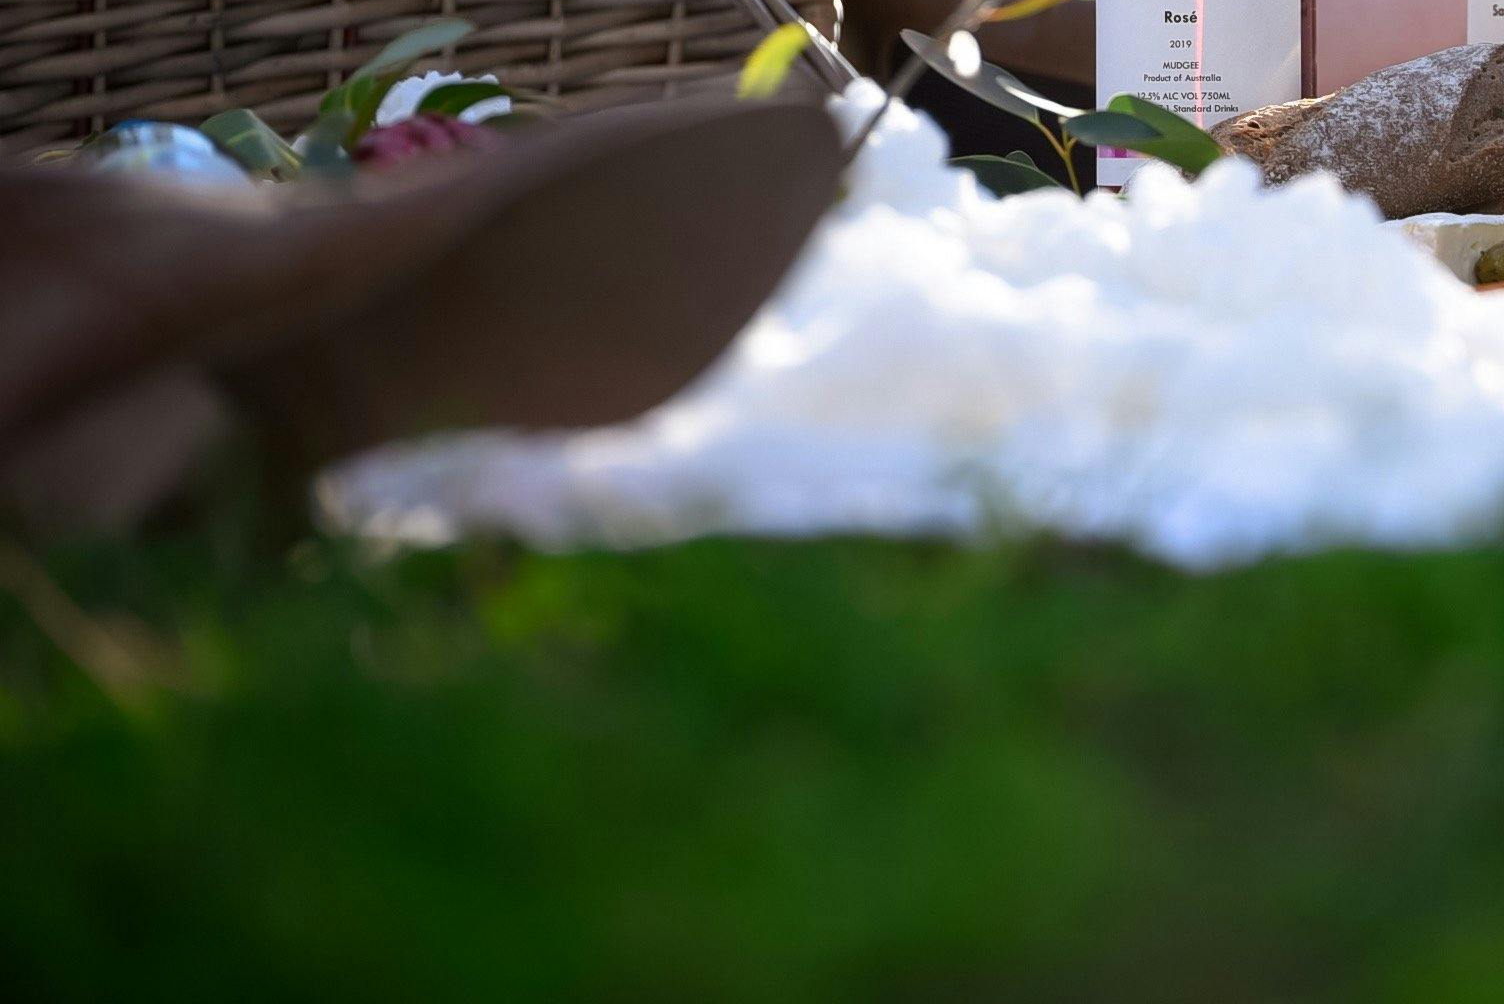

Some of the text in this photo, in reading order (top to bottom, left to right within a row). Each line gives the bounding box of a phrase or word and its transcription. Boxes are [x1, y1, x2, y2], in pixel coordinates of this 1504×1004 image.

[1164, 10, 1198, 24] Rosé
[1169, 40, 1193, 49] 2019
[1163, 61, 1200, 70] MUDGEE
[1144, 74, 1222, 82] Product of Australia
[1163, 92, 1179, 101] ALC
[1180, 92, 1199, 101] VOL
[1201, 92, 1231, 101] 750ML
[1173, 105, 1212, 113] Standard
[1214, 105, 1239, 113] Drinks
